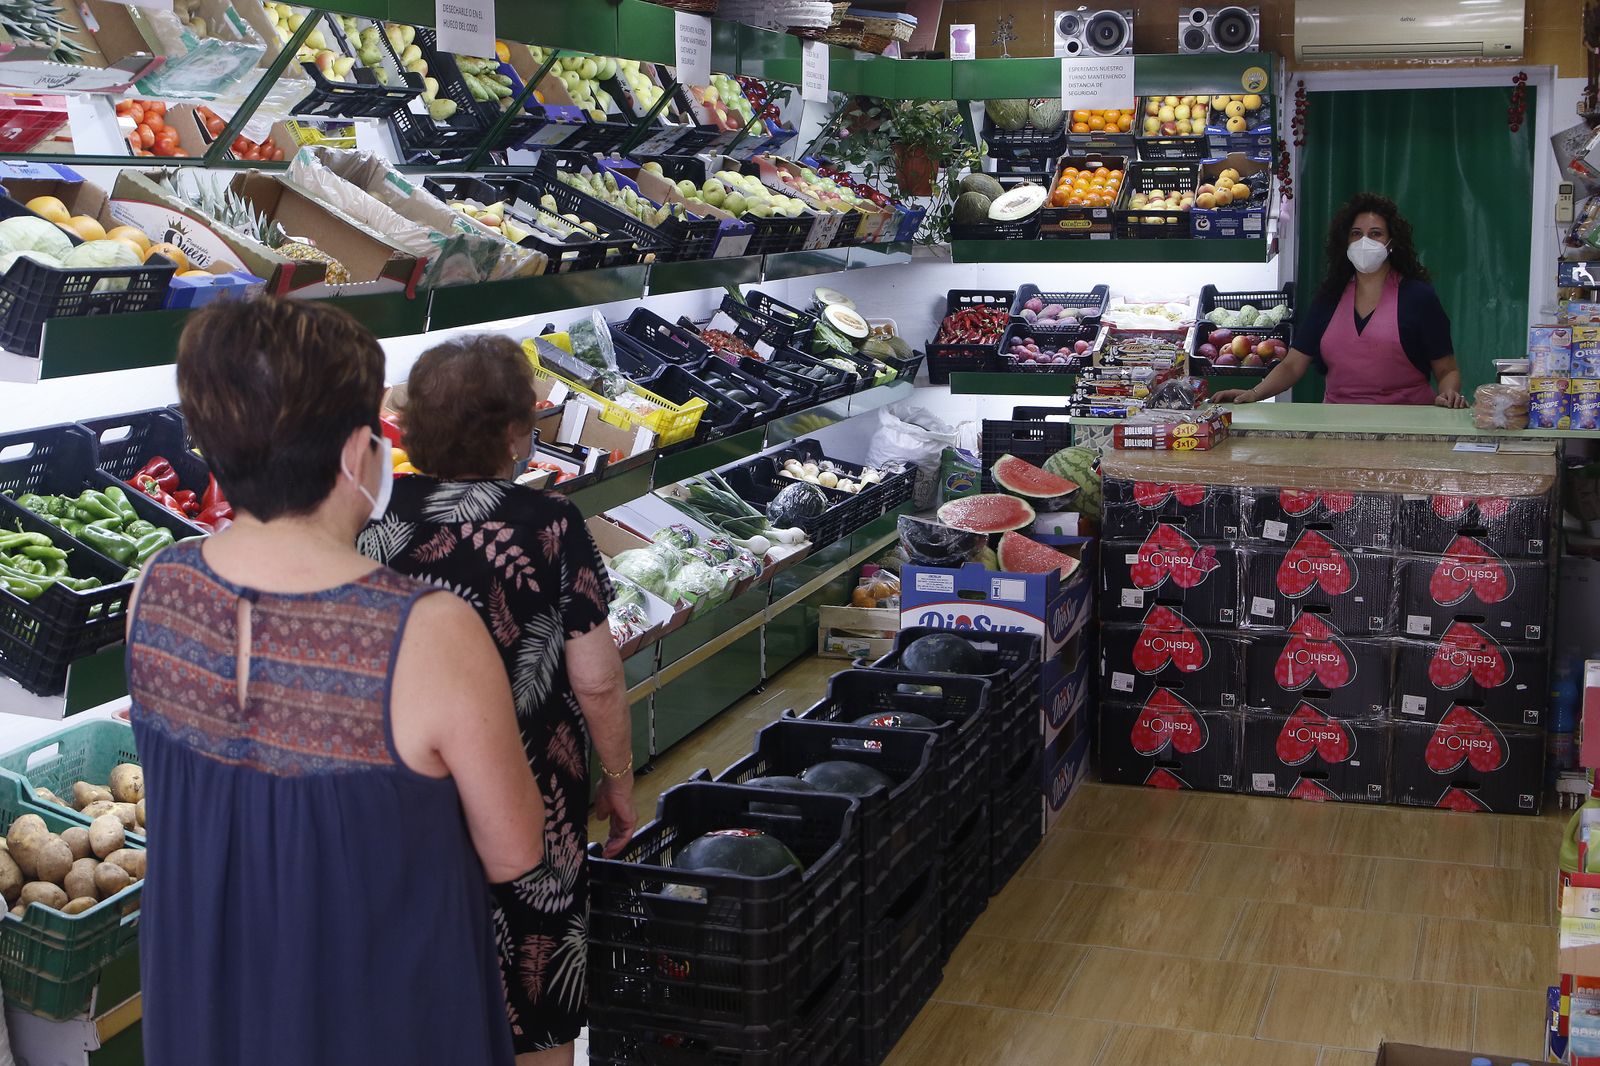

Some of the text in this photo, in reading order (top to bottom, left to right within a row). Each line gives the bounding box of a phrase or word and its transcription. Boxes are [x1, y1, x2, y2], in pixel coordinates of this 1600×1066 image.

[443, 4, 468, 16] DESECHABLE
[164, 229, 208, 266] Queen
[1124, 426, 1153, 435] BOLLYCAO
[1124, 438, 1153, 448] BOLLYCAO
[1142, 552, 1193, 568] fashiOn
[1288, 559, 1342, 575] fashiOn
[1442, 566, 1498, 583] fashiOn
[1144, 637, 1195, 653] fashiOn
[1287, 649, 1341, 666] fashiOn
[1142, 718, 1193, 734] fashiOn
[1288, 728, 1341, 744] fashiOn
[1437, 735, 1493, 752] fashiOn
